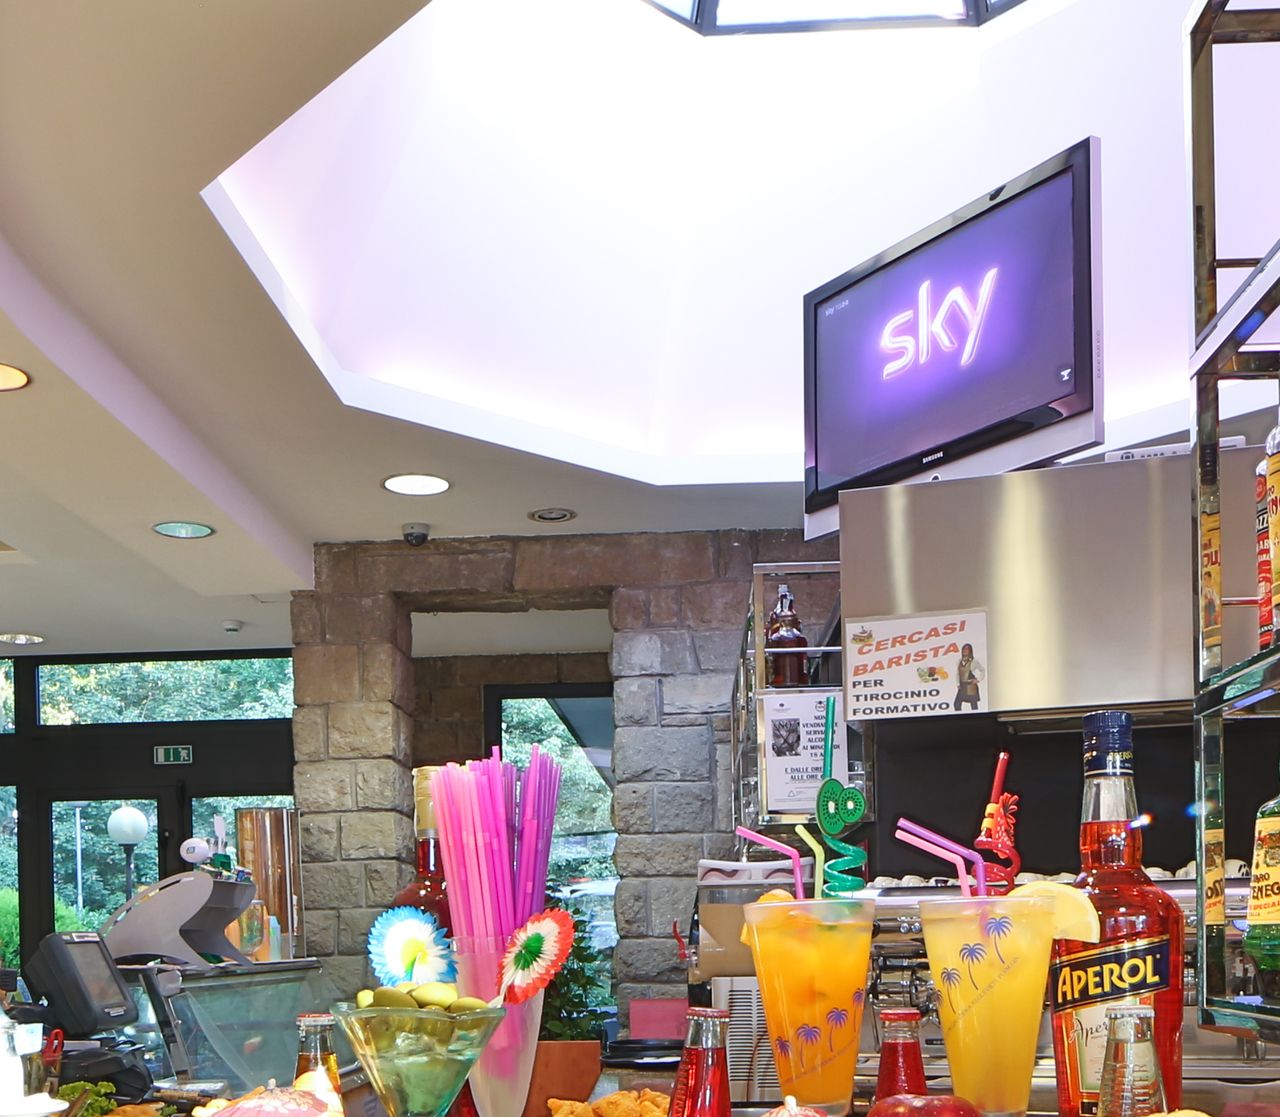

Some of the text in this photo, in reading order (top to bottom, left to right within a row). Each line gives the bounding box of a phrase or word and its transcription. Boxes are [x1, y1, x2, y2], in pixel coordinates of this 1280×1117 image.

[879, 267, 999, 380] sky
[922, 451, 944, 464] SAMSUNG
[857, 619, 967, 656] CERCASI
[852, 642, 960, 677] BARISTA
[852, 678, 884, 689] PER
[852, 688, 940, 702] TIROCINIO
[852, 701, 950, 716] FORMATIVO
[1057, 955, 1160, 1003] APEROL
